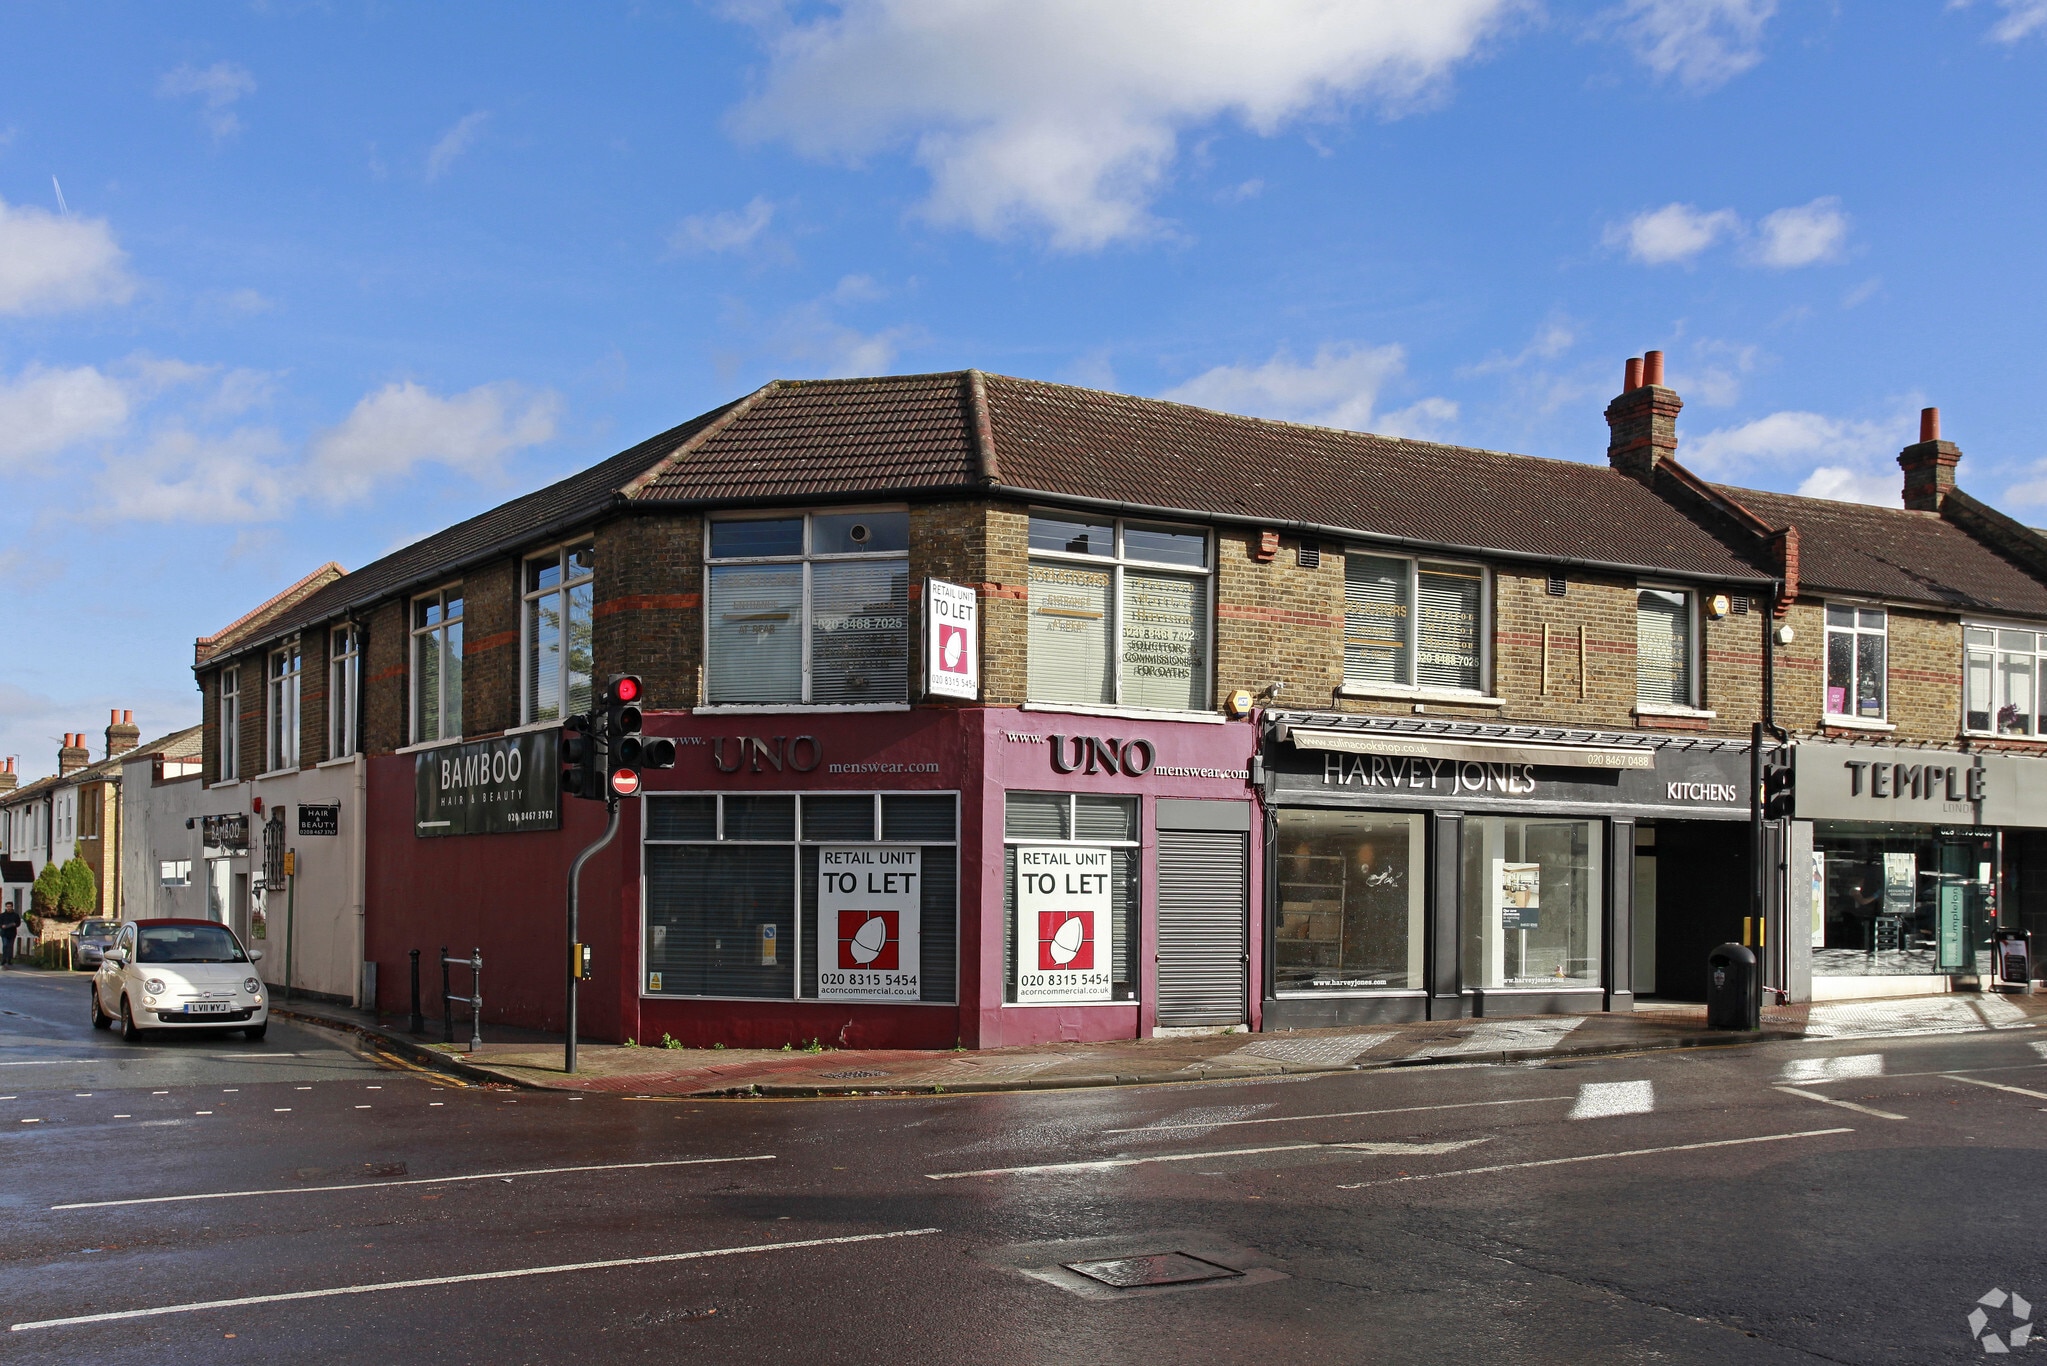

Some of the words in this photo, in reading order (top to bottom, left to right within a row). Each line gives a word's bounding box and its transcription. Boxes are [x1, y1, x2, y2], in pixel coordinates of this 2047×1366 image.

[1032, 566, 1110, 586] SOLICITORS
[932, 584, 956, 599] RETAIL
[957, 589, 974, 602] UNIT
[934, 598, 949, 616] TO
[952, 603, 973, 621] LET
[818, 619, 839, 630] 020
[842, 618, 871, 630] 8468
[874, 617, 903, 629] 7025
[1131, 640, 1187, 654] SOLICITORS
[1124, 651, 1202, 667] COMMISSIONERS
[1458, 656, 1480, 667] 7025
[1158, 666, 1190, 678] OATHS
[932, 674, 944, 684] 020
[945, 676, 960, 687] 8315
[961, 679, 976, 688] 5454
[1301, 737, 1429, 754] www.culinacookshop.co.uk
[711, 735, 823, 773] UNO
[828, 761, 939, 774] menswear.com
[1007, 733, 1045, 744] www.
[1053, 734, 1156, 775] UNO
[1155, 765, 1249, 780] menswear.com
[1587, 754, 1604, 765] 020
[1605, 754, 1626, 766] 8467
[1627, 756, 1649, 767] 0488
[441, 747, 522, 790] BAMBOO
[1322, 753, 1443, 789] HARVEY
[1451, 759, 1536, 796] JONES
[1844, 760, 1987, 802] TEMPLE
[440, 795, 464, 807] HAIR
[482, 789, 523, 803] BEAUTY
[1666, 781, 1736, 802] KITCHENS
[1943, 803, 1980, 814] LOND
[508, 812, 519, 822] 020
[521, 811, 537, 821] 8467
[538, 810, 554, 820] 3767
[211, 822, 240, 841] BAMBOO
[301, 821, 335, 829] BEAUTY
[825, 851, 875, 865] RETAIL
[879, 851, 916, 865] UNIT
[1023, 852, 1071, 865] RETAIL
[1075, 853, 1107, 866] UNIT
[823, 872, 857, 894] TO
[868, 872, 917, 894] LET
[1022, 873, 1056, 894] TO
[1066, 873, 1108, 894] LET
[821, 973, 845, 985] 020
[849, 974, 881, 986] 8315
[885, 974, 917, 986] 5454
[1021, 974, 1044, 986] 020
[1048, 974, 1077, 986] 8315
[1081, 973, 1109, 985] 5454
[1313, 978, 1387, 987] www.harveyjones.com
[821, 987, 917, 996] acorncommercial.co.uk
[1020, 986, 1109, 996] acorncommercial.co.uk
[210, 1003, 226, 1012] WYJ
